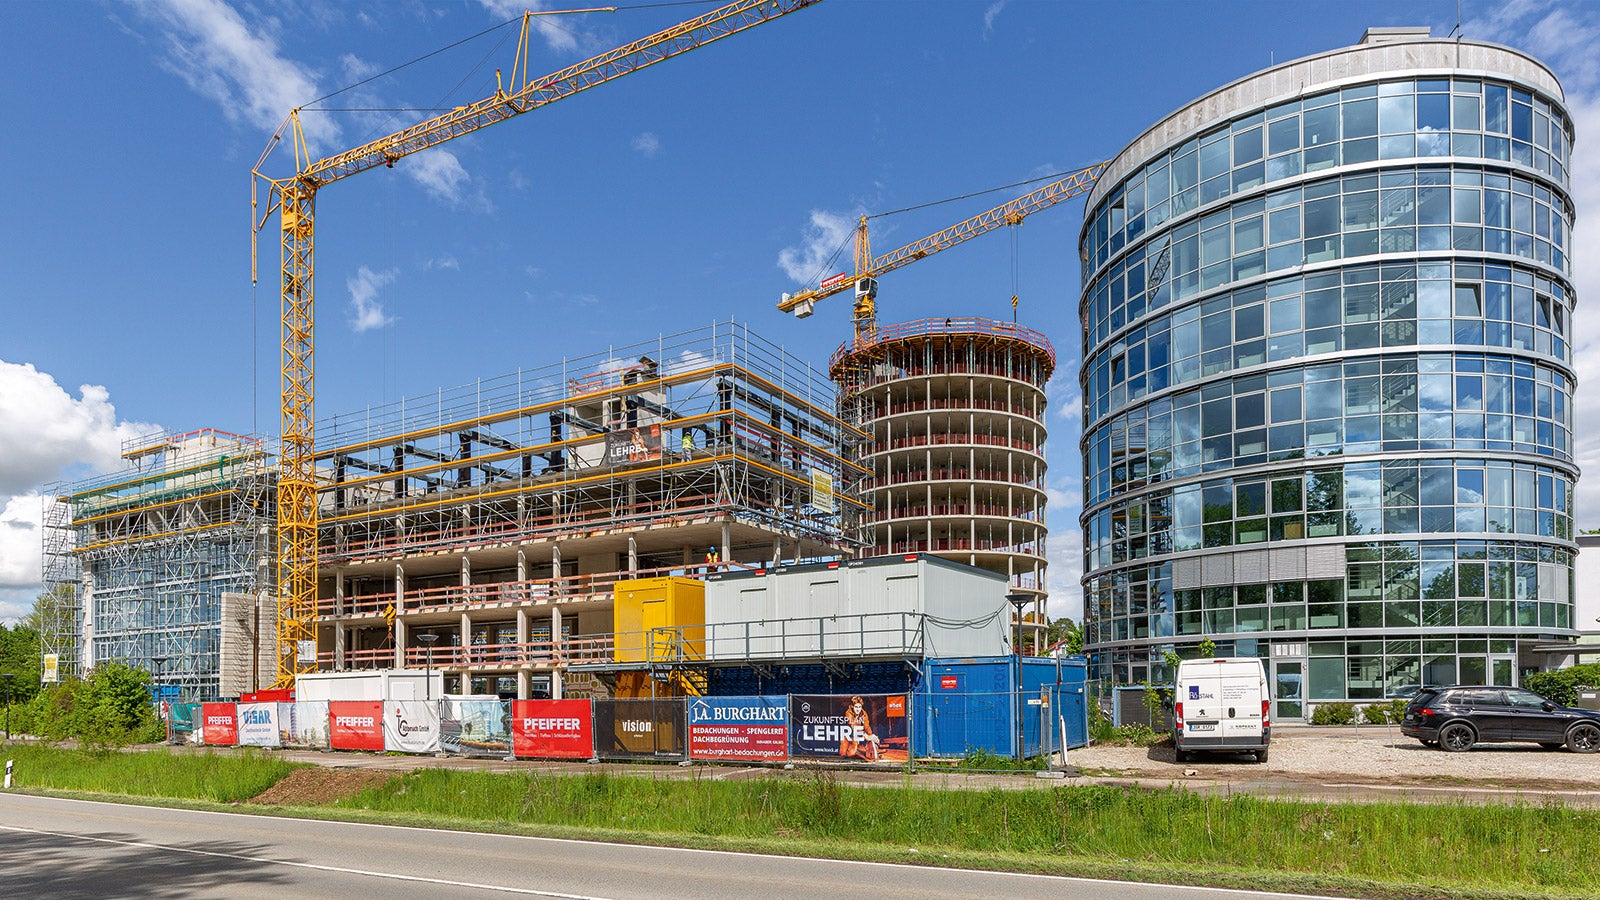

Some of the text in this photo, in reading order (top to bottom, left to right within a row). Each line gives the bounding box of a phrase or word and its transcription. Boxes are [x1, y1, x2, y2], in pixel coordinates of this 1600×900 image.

[611, 444, 641, 457] LEHRE
[692, 706, 786, 723] J.A. BURGHART
[208, 716, 232, 725] PFEIFFER
[336, 716, 374, 727] PFEIFFER
[523, 718, 580, 730] PFEIFFER
[803, 715, 865, 725] ZUKUNFTSPLAN
[746, 727, 783, 735] SPENGLEREI
[802, 724, 865, 741] LEHRE
[693, 735, 749, 744] DACHBEGRÜNUNG
[693, 748, 784, 757] www.burghart-bedachungen.de
